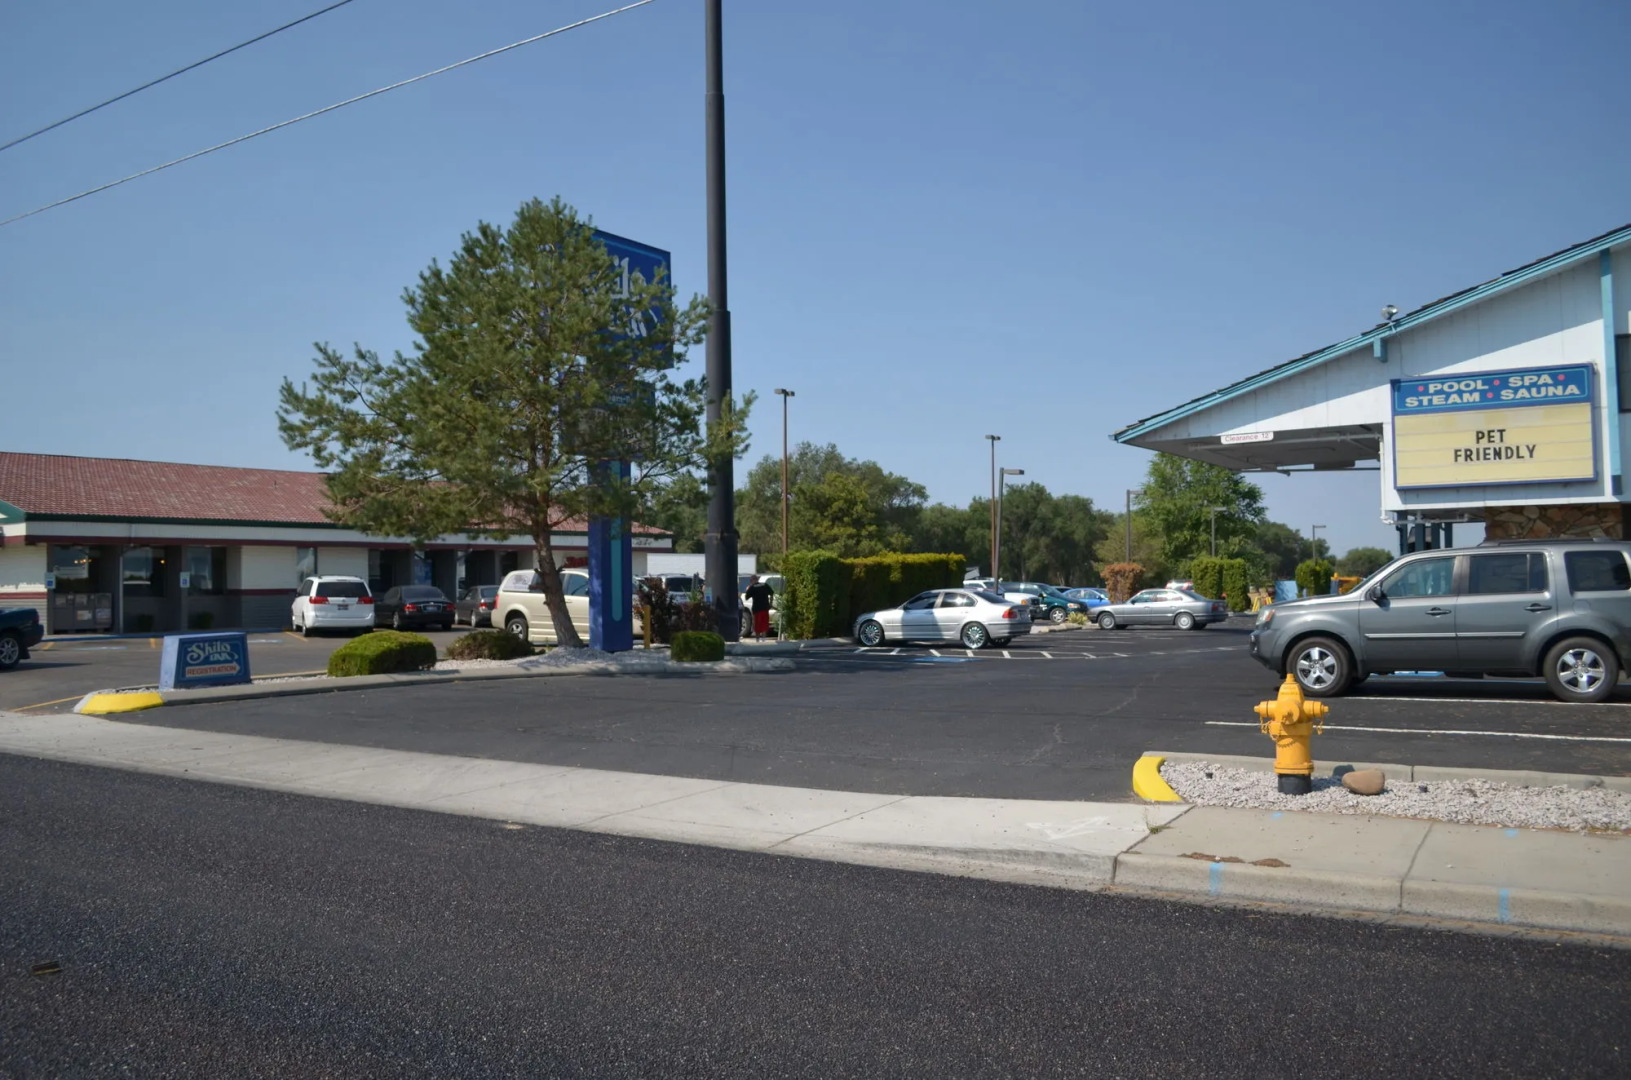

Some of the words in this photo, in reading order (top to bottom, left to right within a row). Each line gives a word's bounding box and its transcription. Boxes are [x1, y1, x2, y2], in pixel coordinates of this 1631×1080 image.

[1428, 380, 1489, 393] POOL
[1508, 374, 1553, 387] SPA
[1405, 392, 1480, 407] STEAM
[1500, 385, 1580, 400] SAUNA
[1225, 434, 1259, 442] Clearance
[1475, 429, 1506, 444] PET
[1453, 444, 1536, 462] FRIENDLY
[186, 640, 231, 664] Shilo
